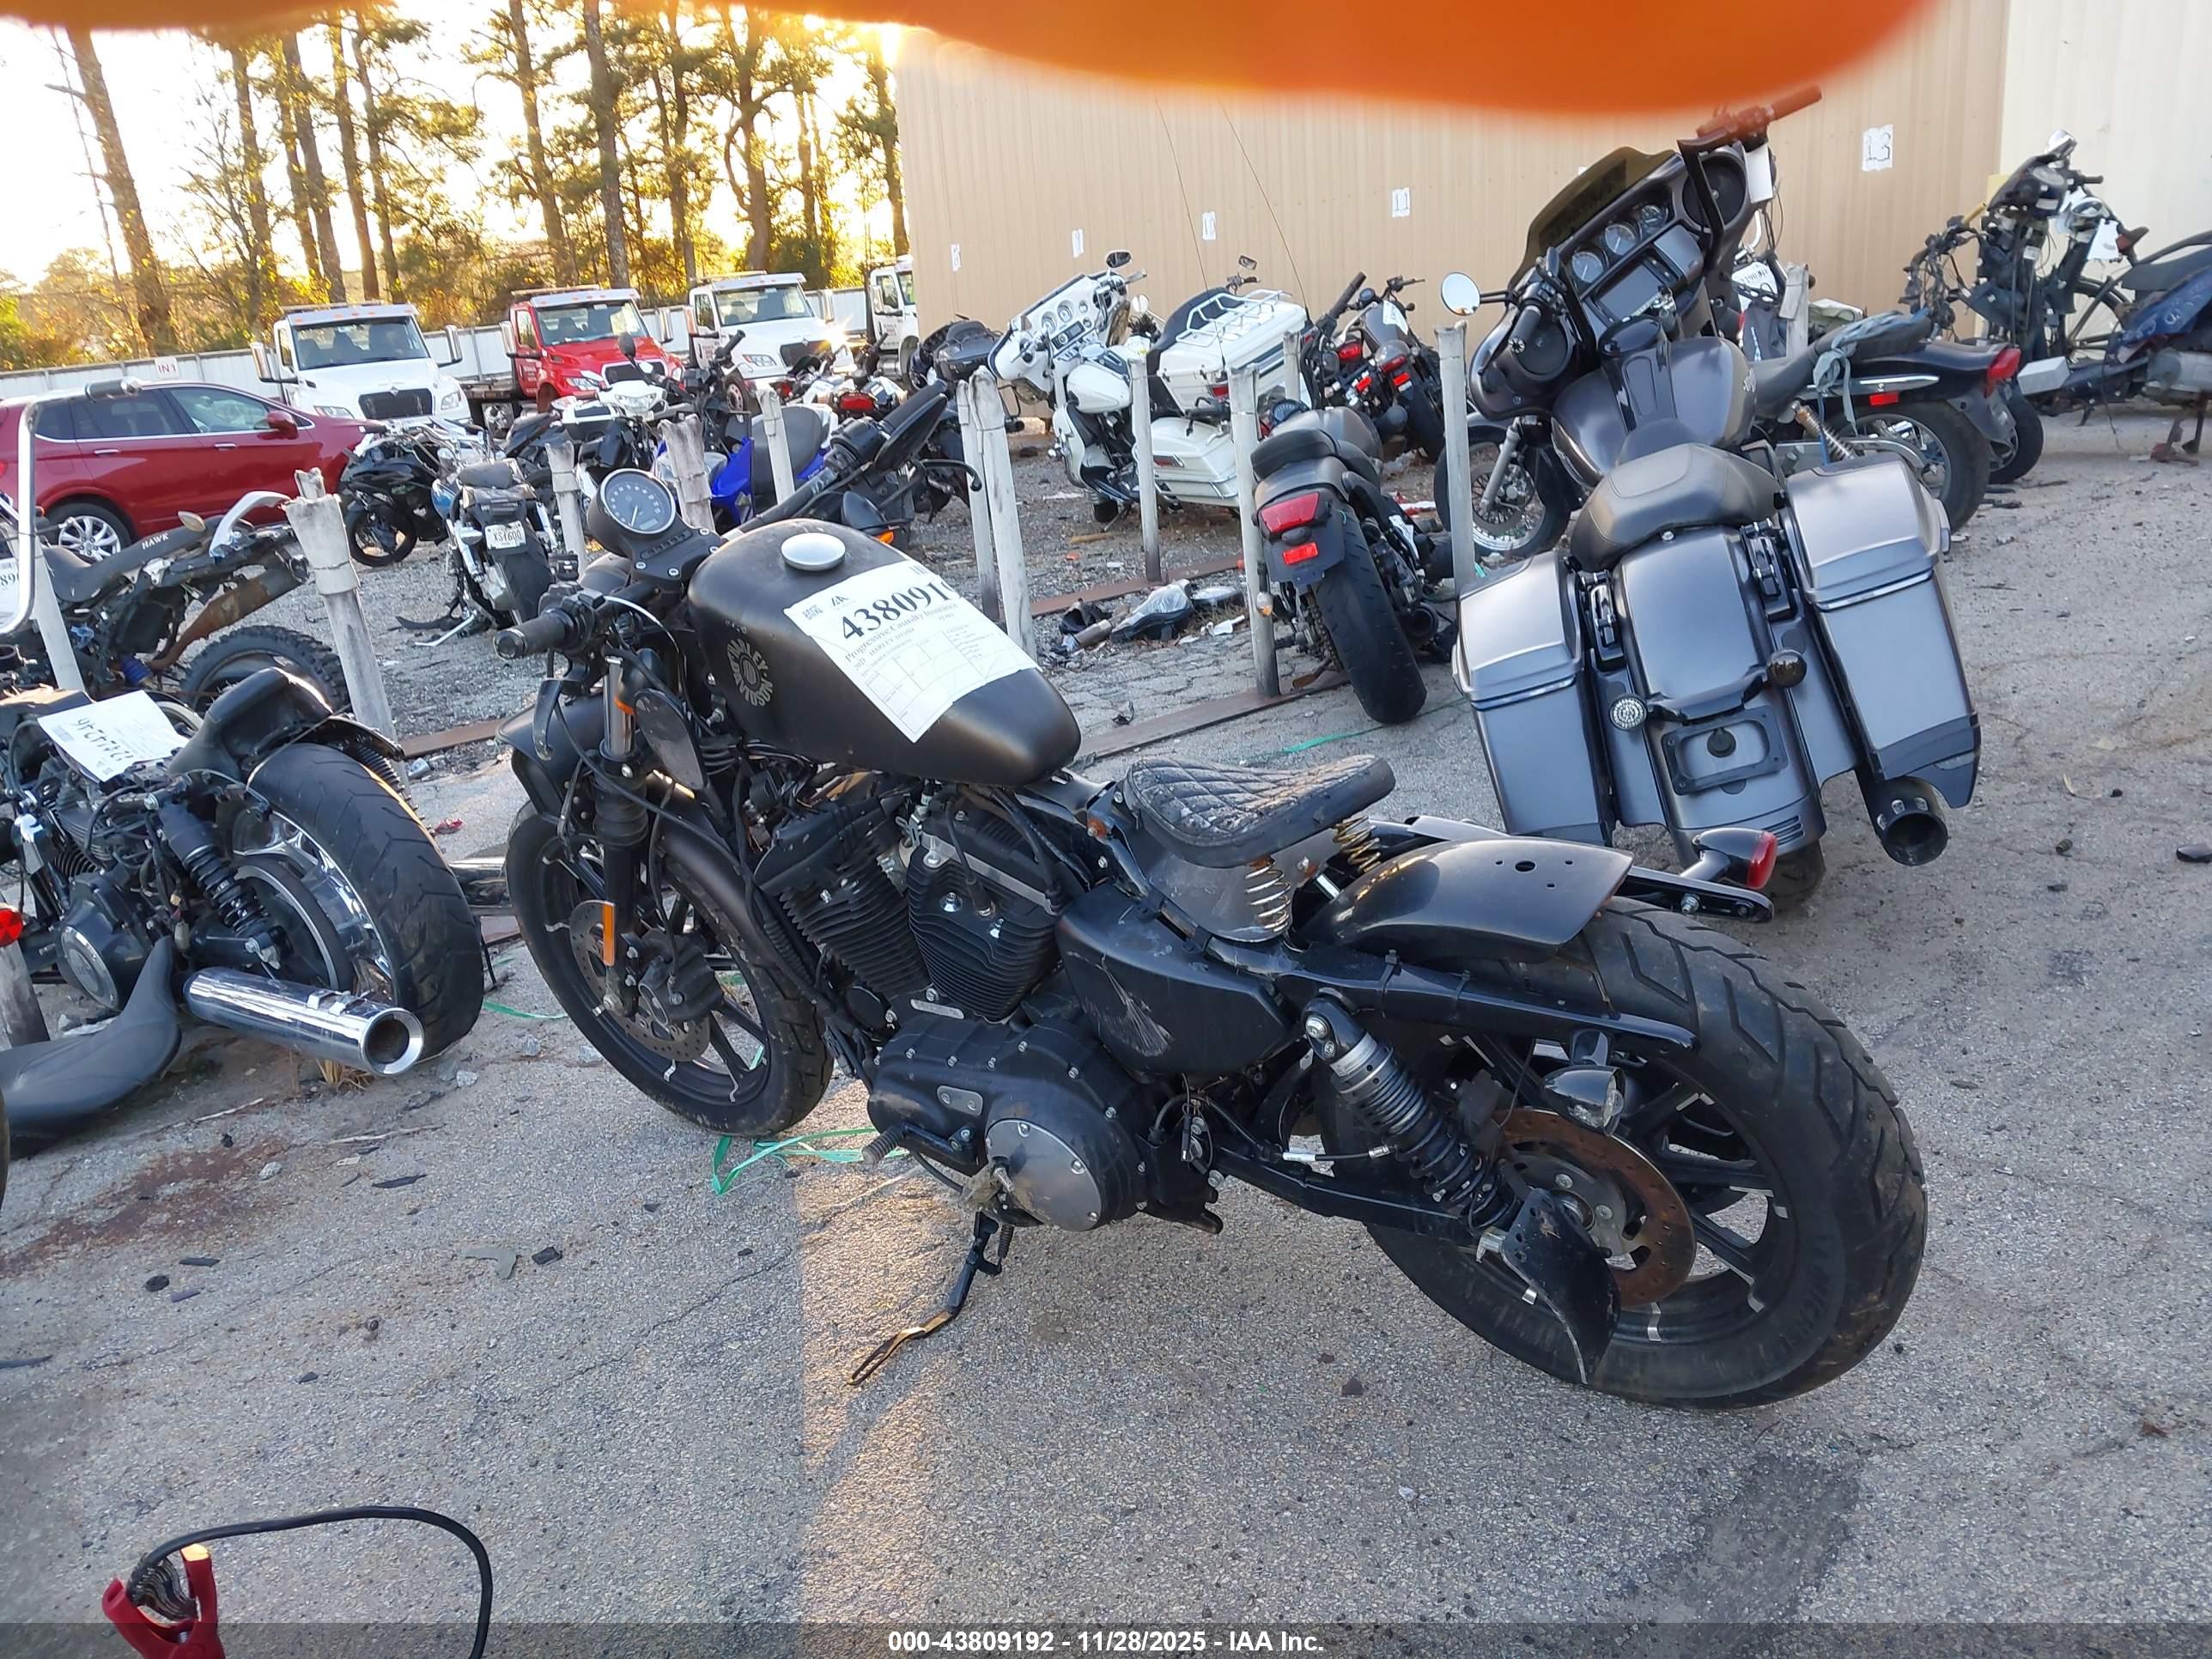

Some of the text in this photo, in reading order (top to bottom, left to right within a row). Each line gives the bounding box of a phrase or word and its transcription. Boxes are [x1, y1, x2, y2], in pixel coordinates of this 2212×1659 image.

[1867, 131, 1891, 162] 13
[141, 532, 169, 550] HAWK
[844, 628, 891, 664] Progressive
